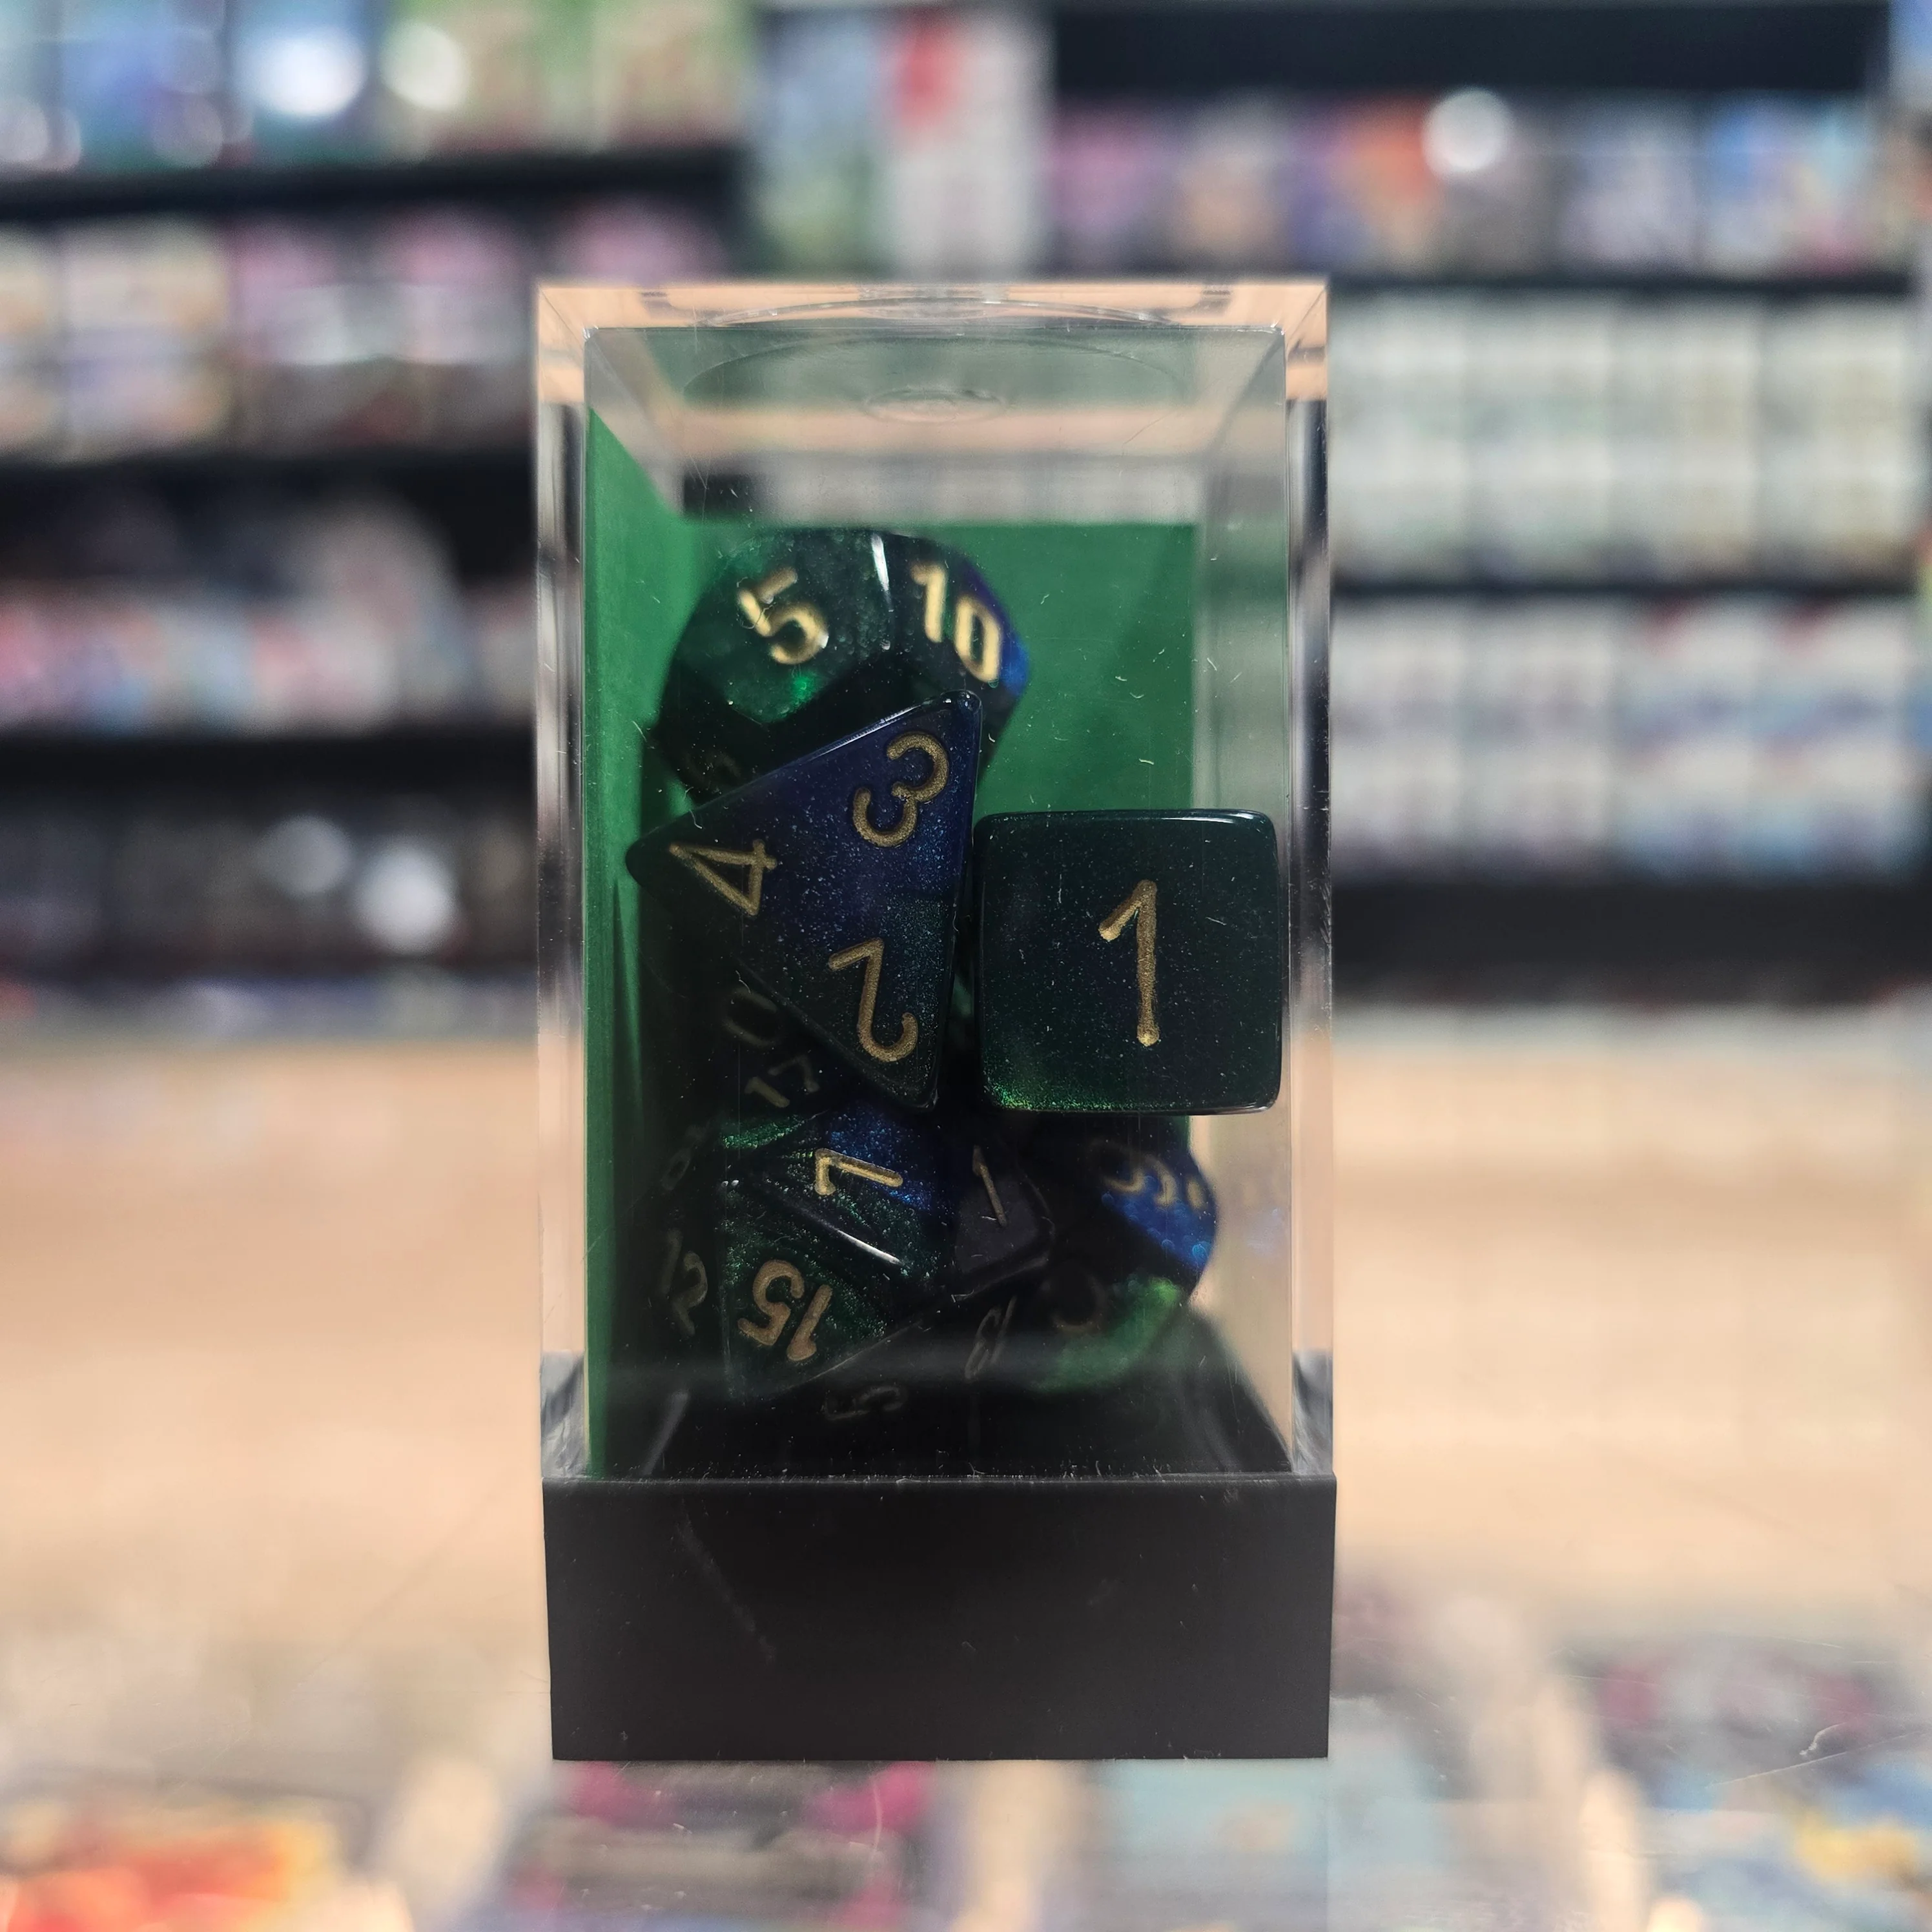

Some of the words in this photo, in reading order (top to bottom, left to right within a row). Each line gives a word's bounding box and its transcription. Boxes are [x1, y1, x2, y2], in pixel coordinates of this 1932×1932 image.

[737, 568, 828, 664] 5
[911, 562, 1003, 683] 10
[852, 732, 949, 847] 3
[669, 840, 777, 916] 4
[828, 938, 918, 1062] 2
[1098, 879, 1160, 1047] 1
[737, 1259, 833, 1361] 15
